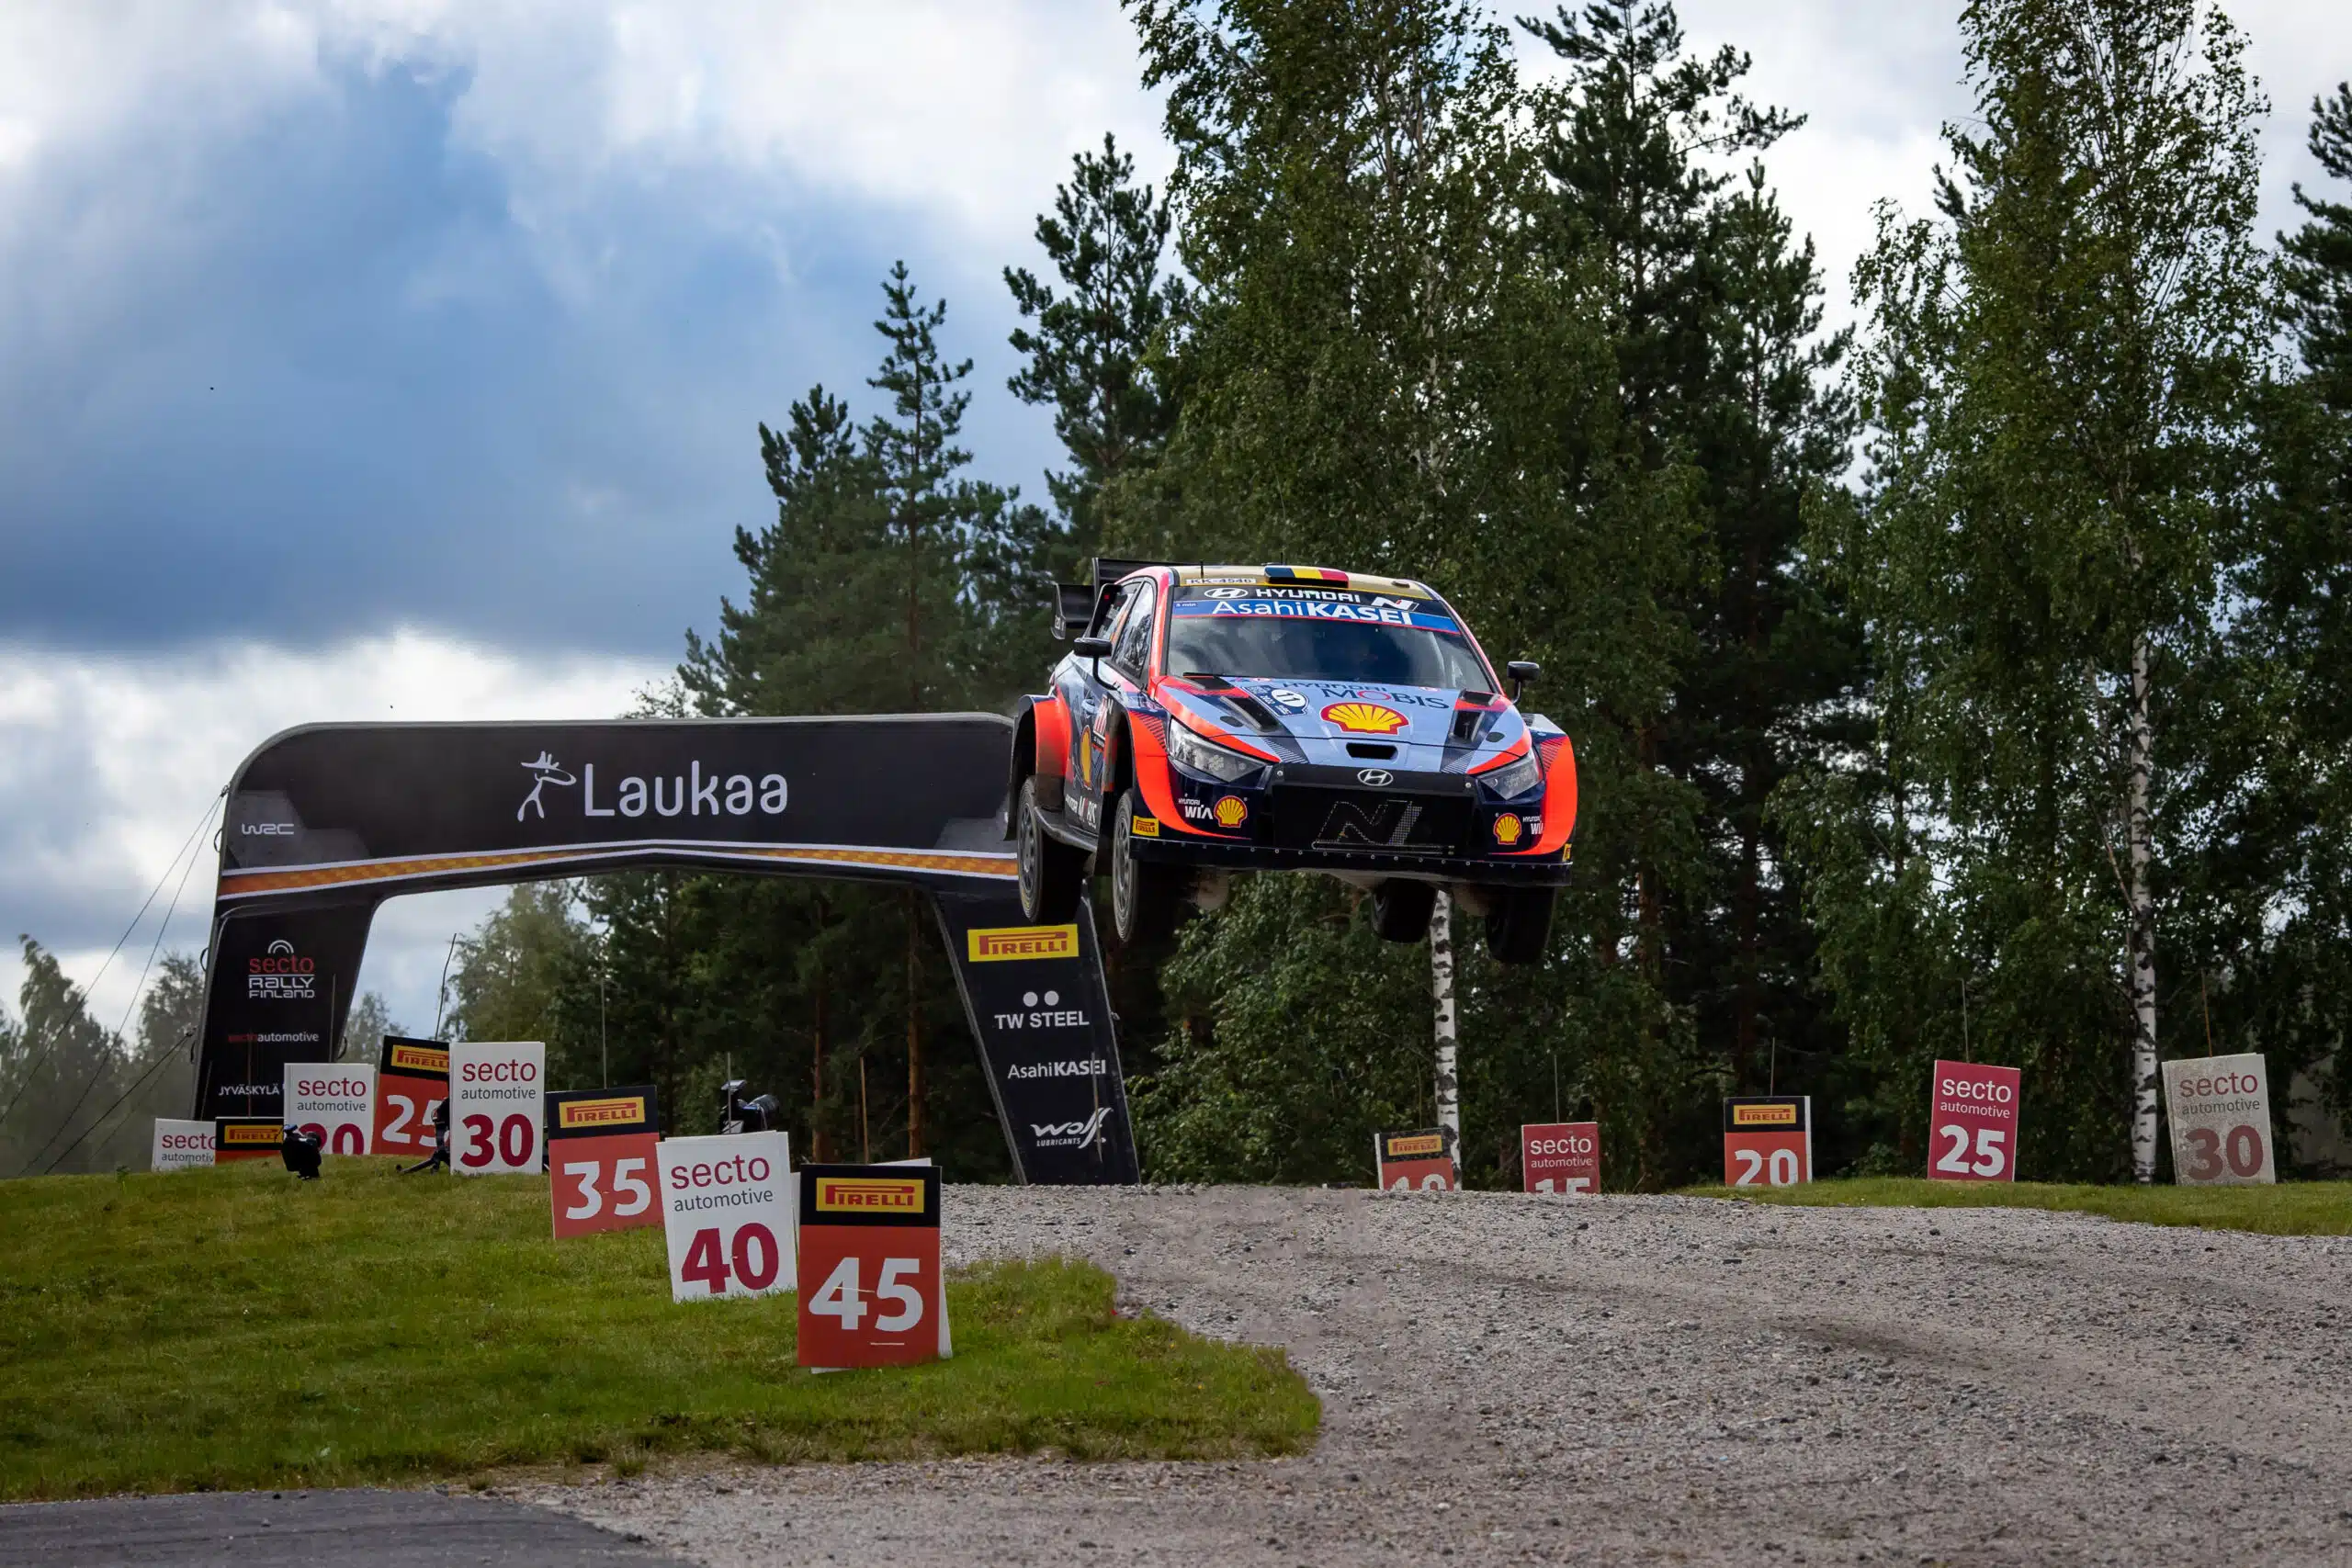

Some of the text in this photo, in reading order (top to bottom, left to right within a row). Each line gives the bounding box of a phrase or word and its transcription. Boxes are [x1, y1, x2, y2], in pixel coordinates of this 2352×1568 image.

[1256, 589, 1360, 603] HYUNDAI
[1213, 601, 1412, 625] AsahiKASEI
[1321, 688, 1449, 709] MOBIS
[584, 760, 788, 818] Laukaa
[1185, 805, 1213, 819] WIA
[242, 823, 294, 835] WRC
[978, 931, 1068, 955] PIRELLI
[249, 954, 314, 974] secto
[994, 1010, 1090, 1030] TW STEEL
[462, 1059, 537, 1082] secto
[1007, 1060, 1106, 1079] AsahiKASEI
[218, 1081, 280, 1096] JYVÄSKYLÄ
[298, 1077, 367, 1097] secto
[461, 1086, 537, 1100] automotive
[1941, 1077, 2012, 1103] secto
[2179, 1072, 2258, 1098] secto
[297, 1100, 367, 1111] automotive
[566, 1102, 637, 1123] PIRELLI
[1738, 1108, 1791, 1121] PIRELLI
[1939, 1100, 2010, 1119] automotive
[2181, 1098, 2260, 1115] automotive
[460, 1113, 534, 1168] 30
[1036, 1137, 1081, 1147] LUBRICANTS
[1392, 1139, 1438, 1153] PIRELLI
[1530, 1135, 1592, 1155] secto
[162, 1152, 214, 1162] automotiv
[1936, 1124, 2006, 1178] 25
[2185, 1124, 2264, 1181] 30
[671, 1154, 771, 1190] secto
[1531, 1156, 1593, 1168] automotive
[1735, 1148, 1799, 1188] 20
[563, 1157, 651, 1220] 35
[825, 1184, 915, 1206] PIRELLI
[673, 1187, 774, 1213] automotive
[681, 1222, 779, 1294] 40
[808, 1257, 923, 1332] 45
